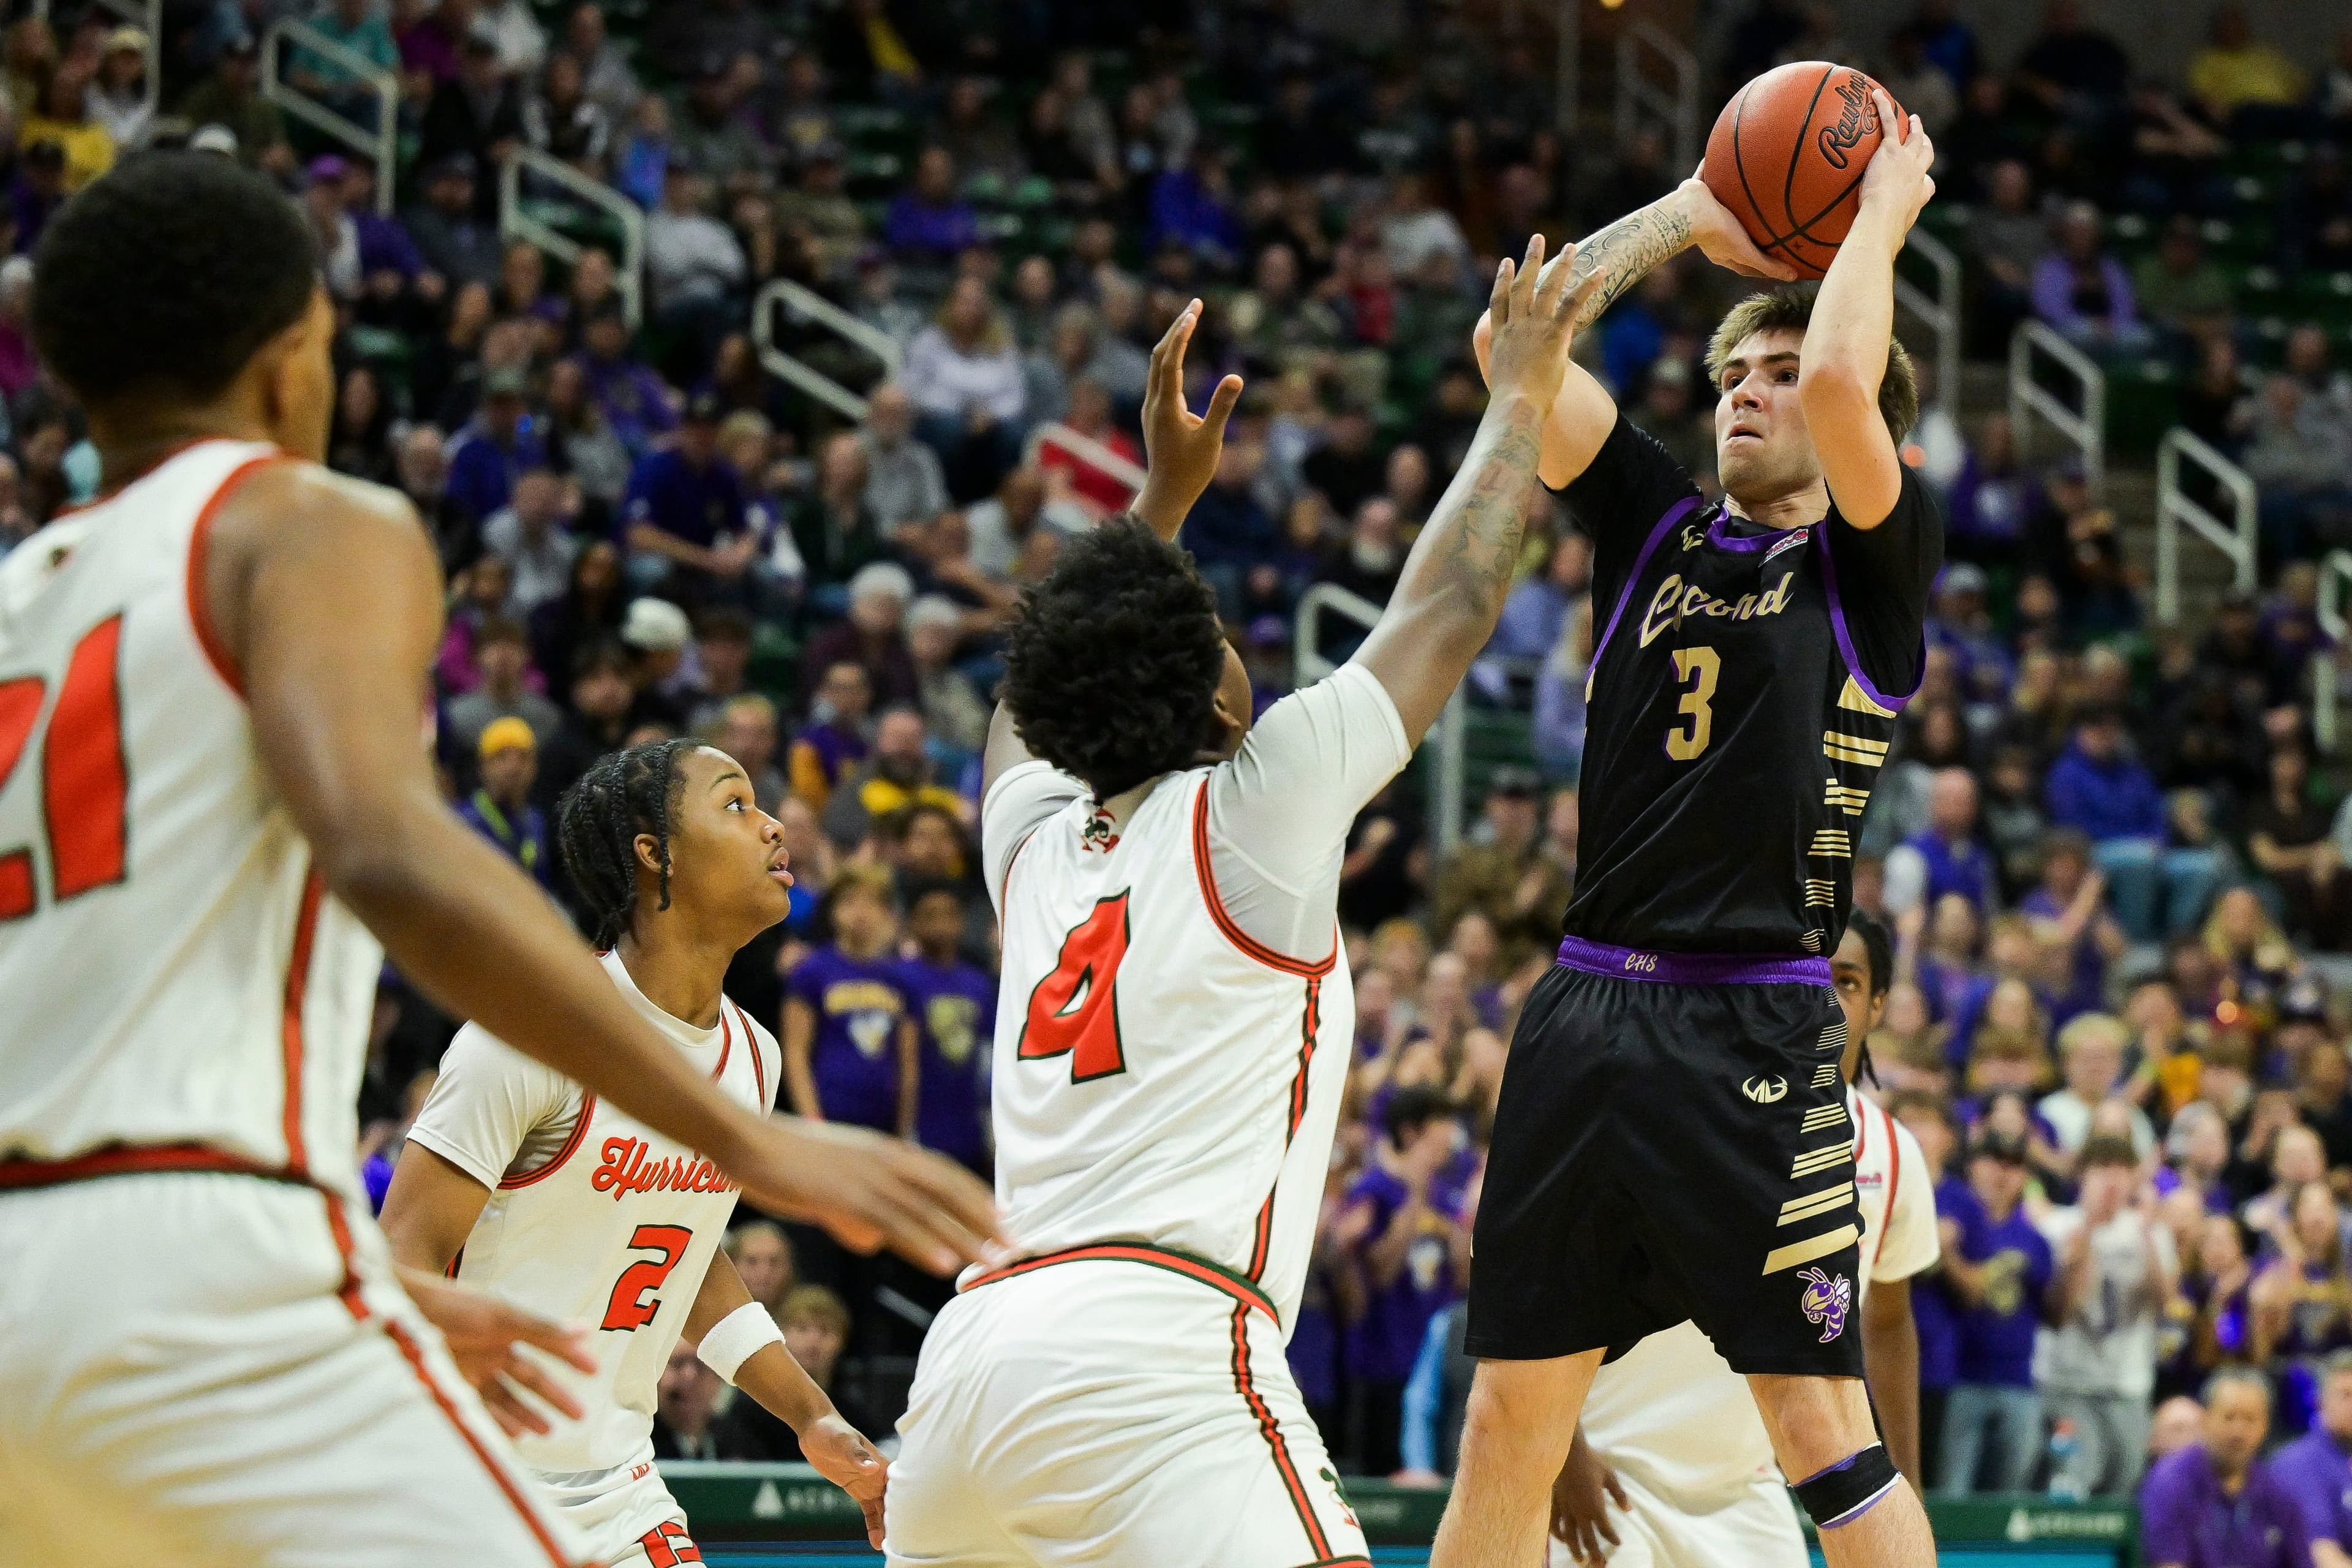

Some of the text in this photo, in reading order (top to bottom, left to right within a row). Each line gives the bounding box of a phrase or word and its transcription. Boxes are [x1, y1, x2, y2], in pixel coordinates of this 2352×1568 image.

[1818, 72, 1875, 170] Rawling
[1664, 646, 1721, 761] 3
[1017, 886, 1131, 1085] 4
[1625, 953, 1657, 972] CHS
[600, 1224, 693, 1332] 2
